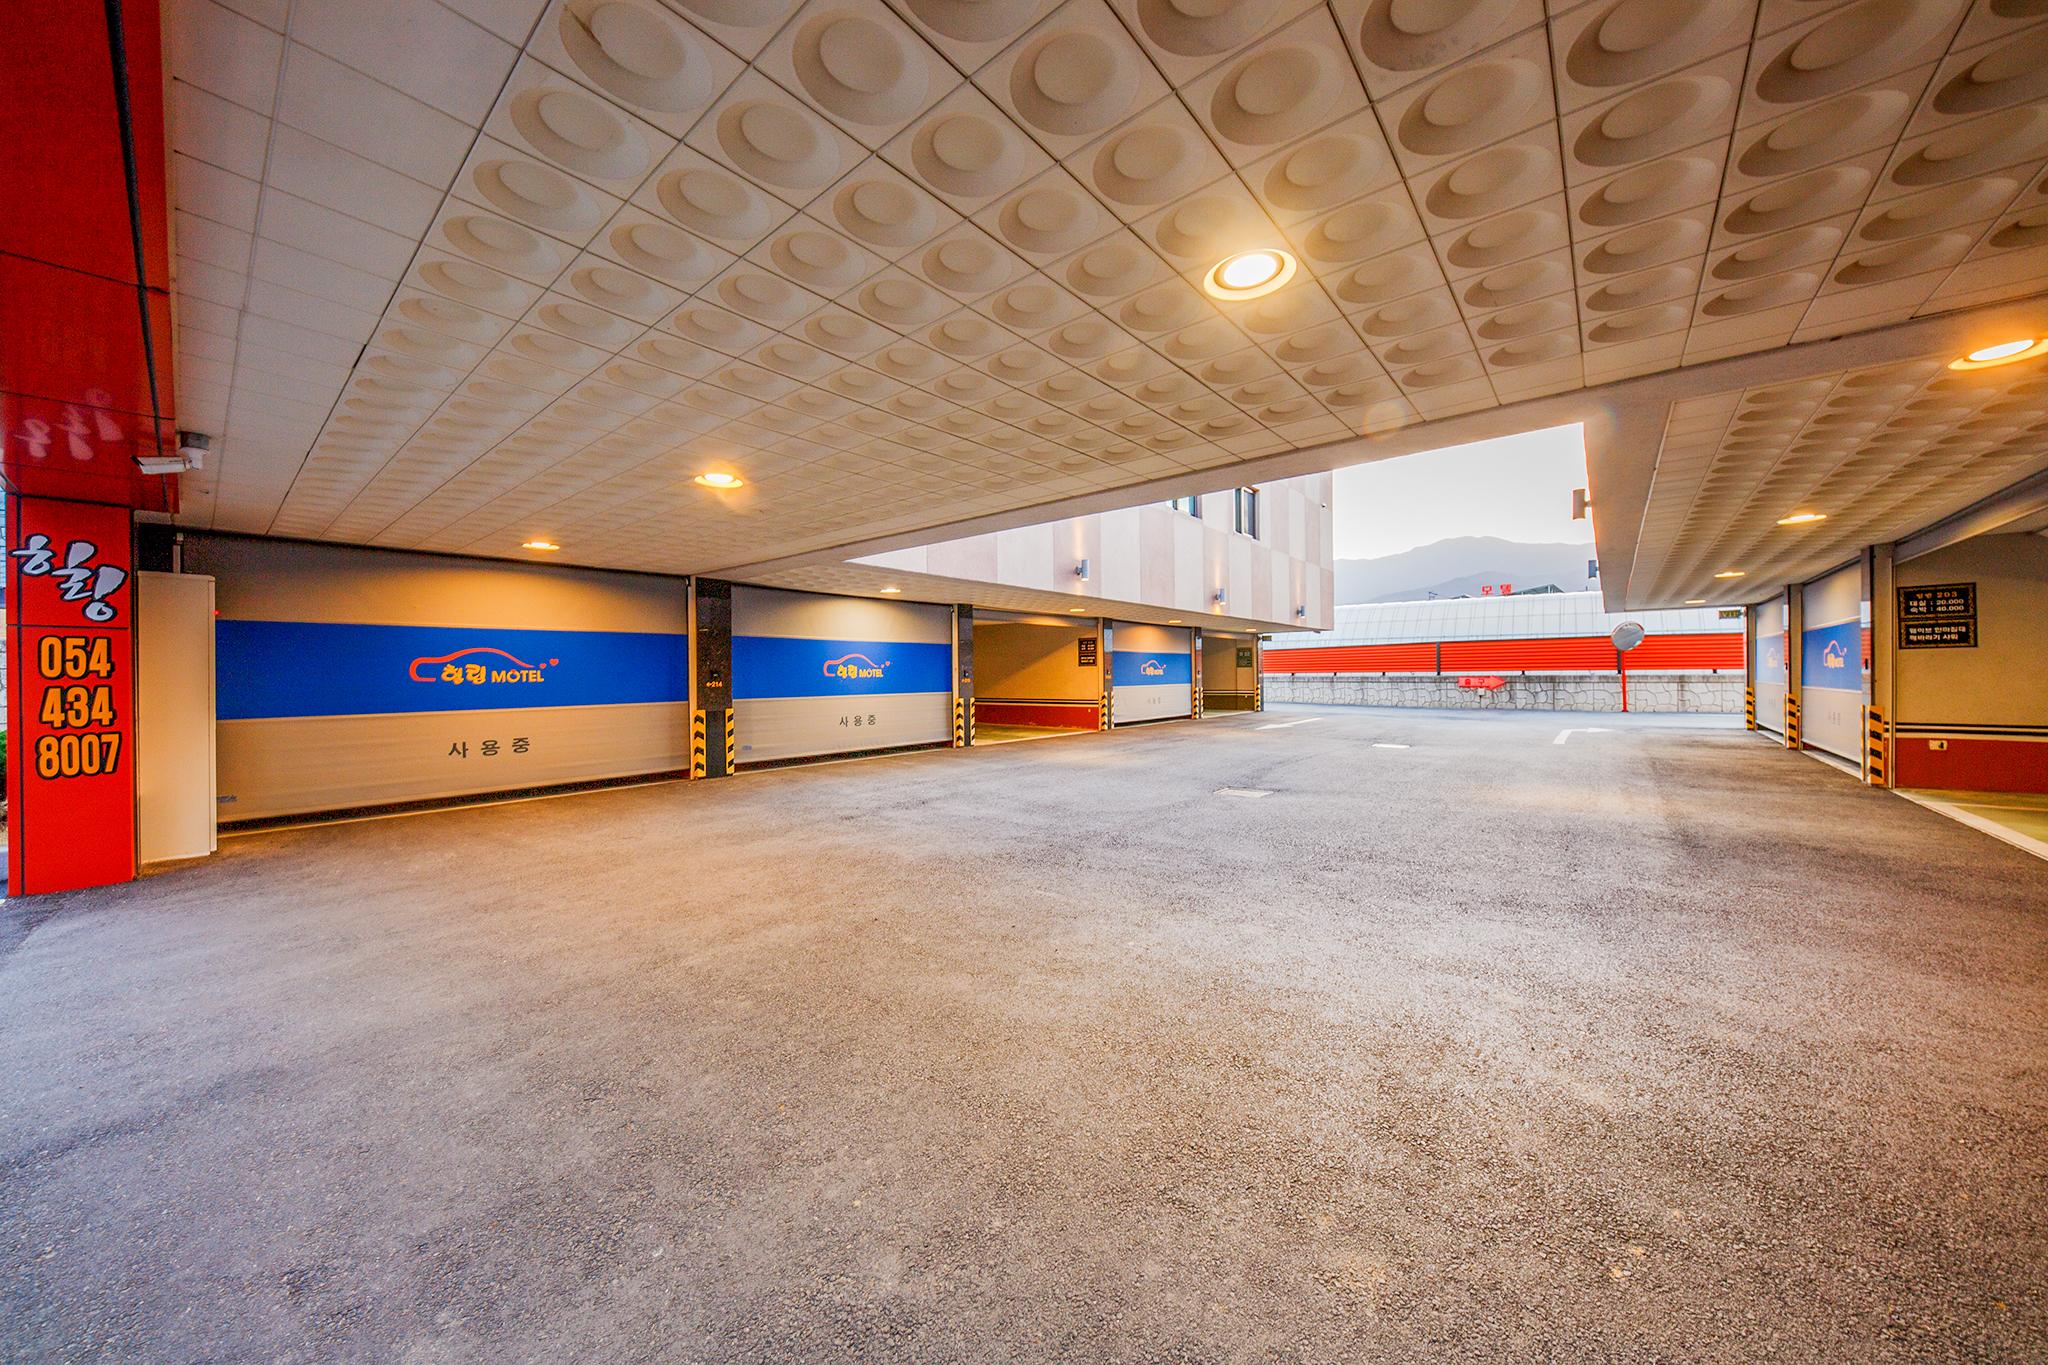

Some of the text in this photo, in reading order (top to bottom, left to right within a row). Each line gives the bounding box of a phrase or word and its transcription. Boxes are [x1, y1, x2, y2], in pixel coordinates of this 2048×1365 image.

[38, 636, 114, 680] 054
[491, 669, 545, 683] MOTEL
[859, 668, 884, 678] MOTEL
[40, 685, 116, 729] 434
[36, 732, 121, 780] 8007
